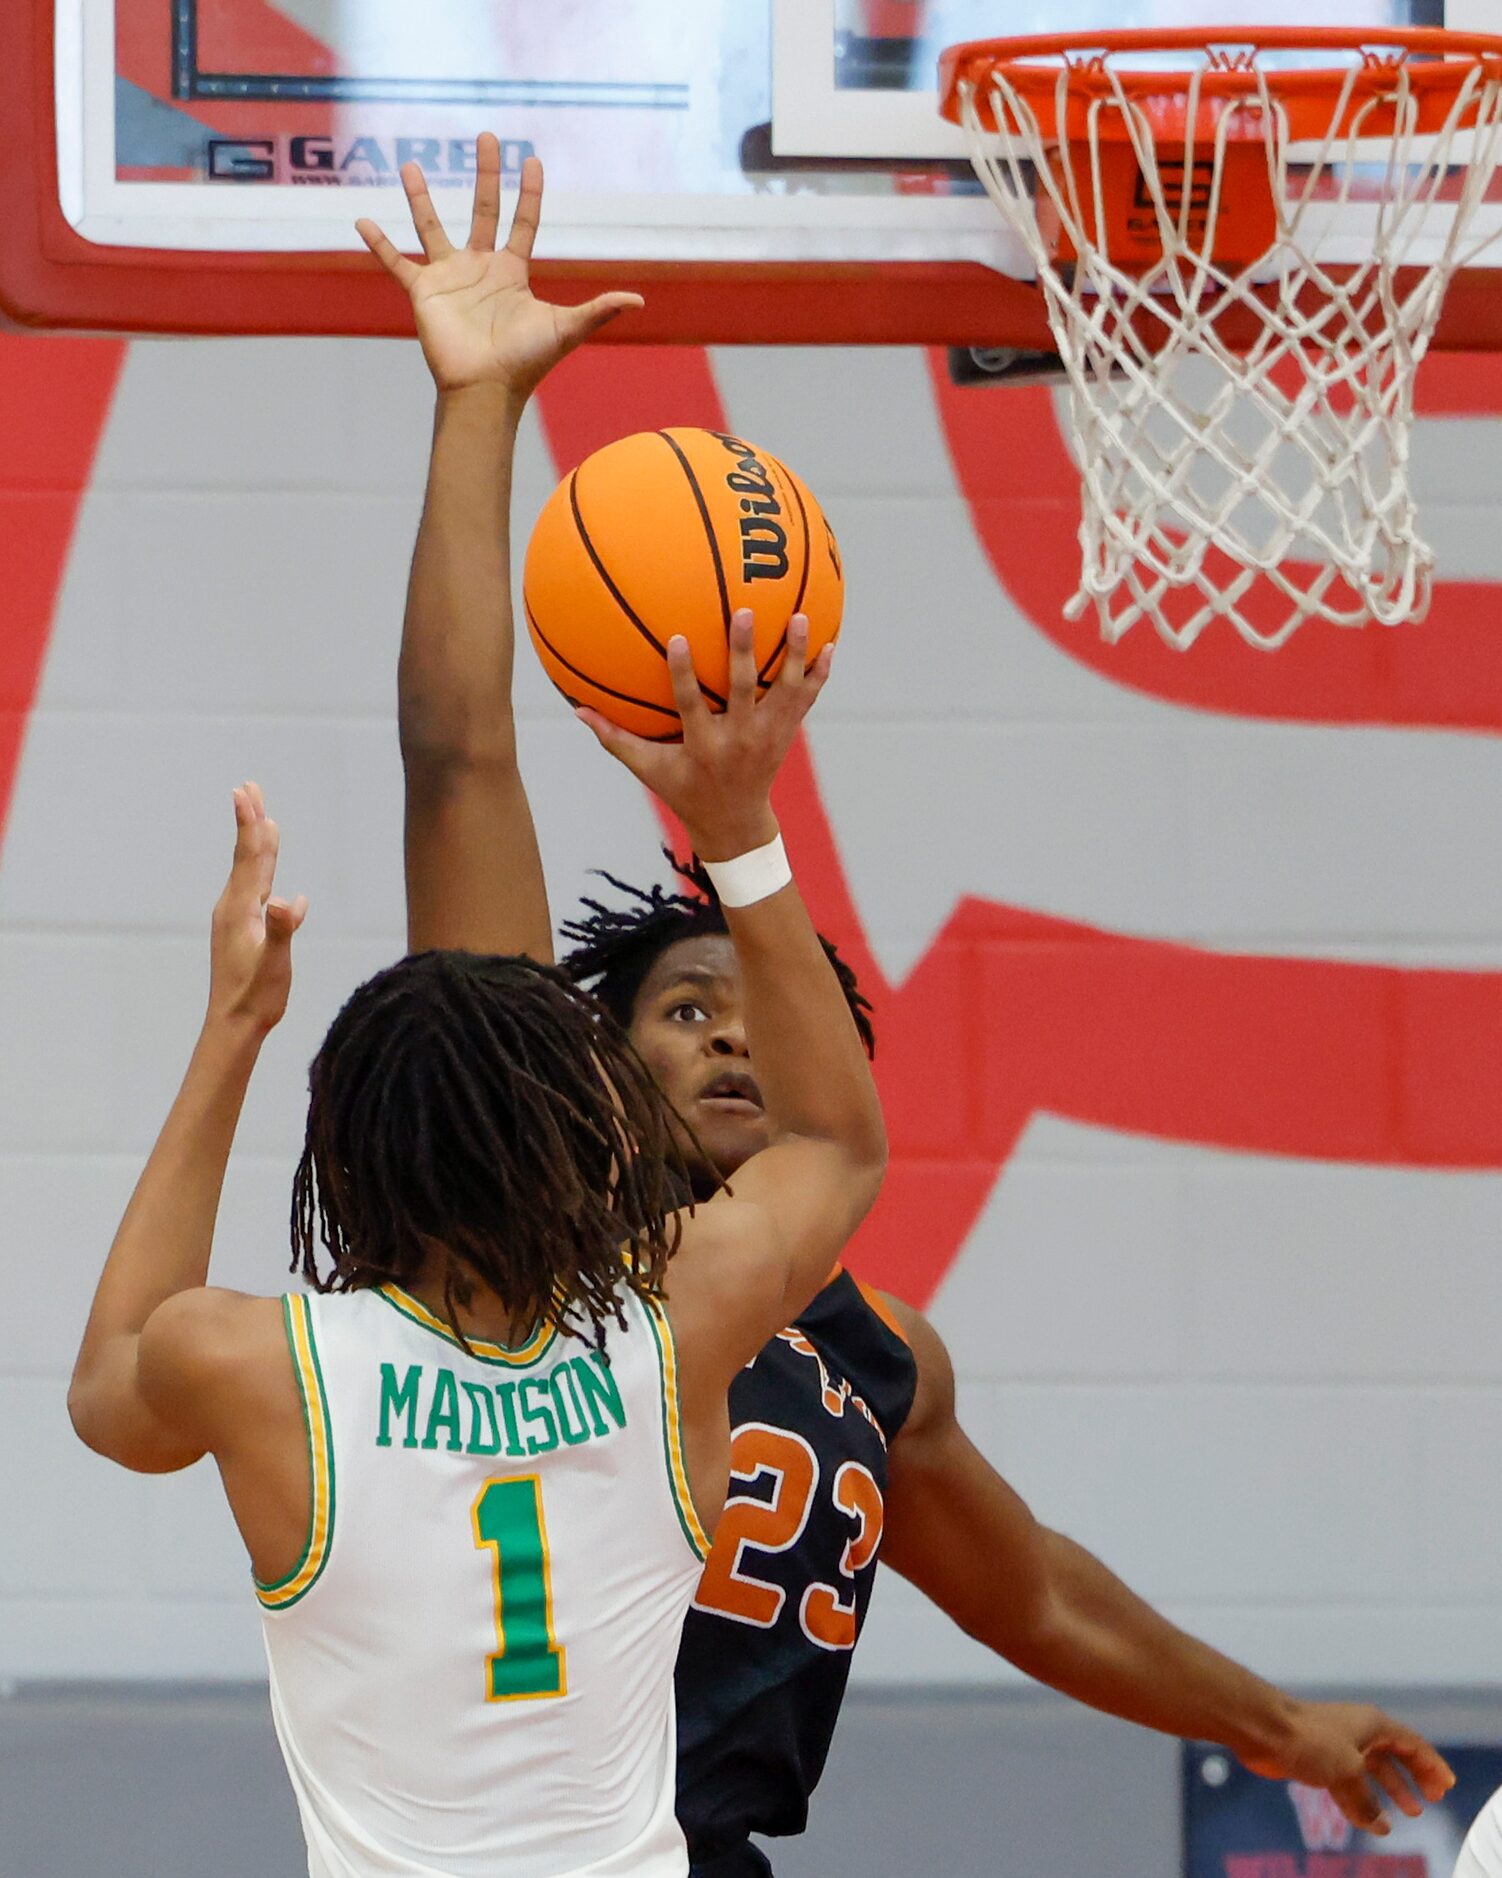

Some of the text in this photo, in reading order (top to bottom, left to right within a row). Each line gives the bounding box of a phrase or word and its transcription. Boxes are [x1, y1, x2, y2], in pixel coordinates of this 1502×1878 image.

[290, 136, 536, 173] GARED
[376, 1350, 628, 1457] MADISON
[469, 1473, 568, 1703] 1
[690, 1421, 884, 1651] 23
